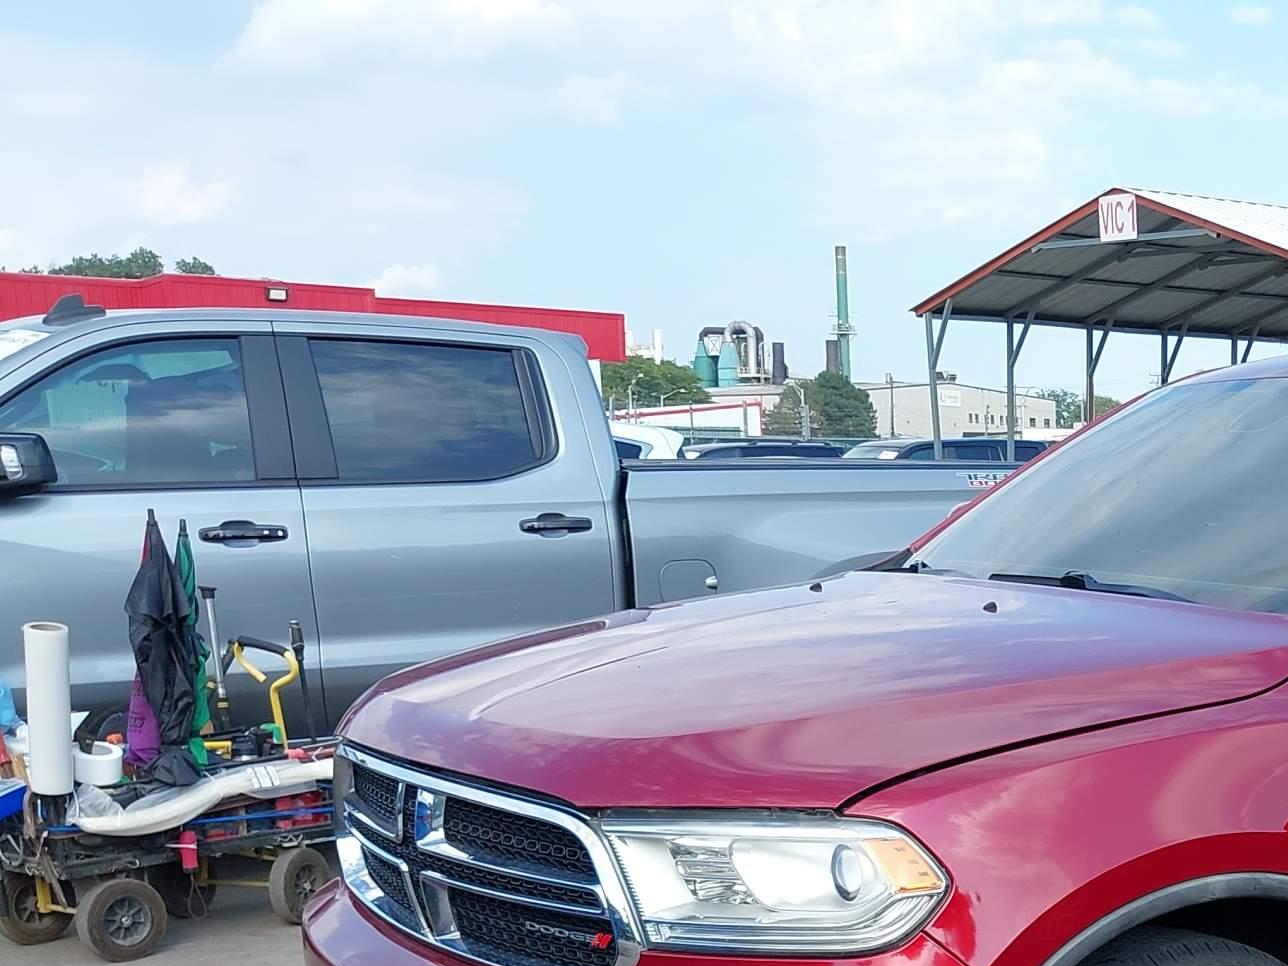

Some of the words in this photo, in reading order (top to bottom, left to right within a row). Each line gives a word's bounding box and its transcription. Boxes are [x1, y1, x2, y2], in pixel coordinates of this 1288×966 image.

[1100, 200, 1125, 235] VIC
[1127, 199, 1136, 232] 1
[525, 921, 599, 944] DODGE
